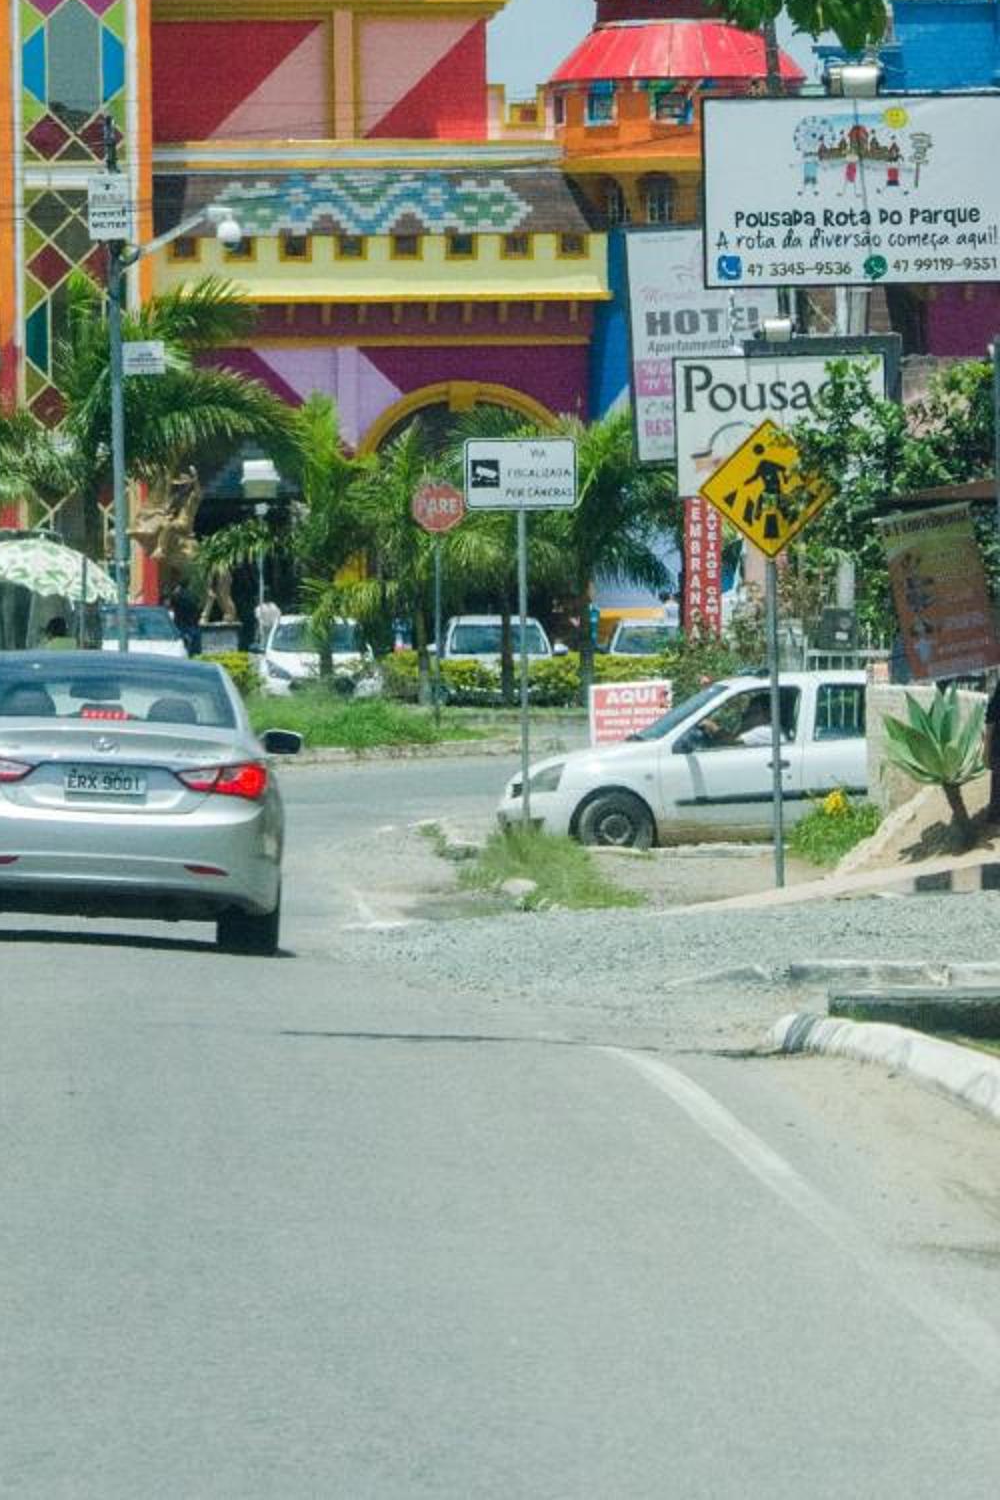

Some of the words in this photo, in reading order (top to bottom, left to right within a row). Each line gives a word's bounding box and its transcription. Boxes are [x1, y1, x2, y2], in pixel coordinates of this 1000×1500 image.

[715, 231, 729, 249] A
[737, 230, 776, 249] rota
[782, 228, 801, 248] da
[810, 227, 881, 249] diversão
[888, 231, 949, 251] começa
[957, 225, 998, 248] aqui!
[747, 263, 764, 277] 47
[770, 261, 852, 276] 3345-9536
[892, 258, 909, 272] 47
[605, 687, 657, 705] AQUI
